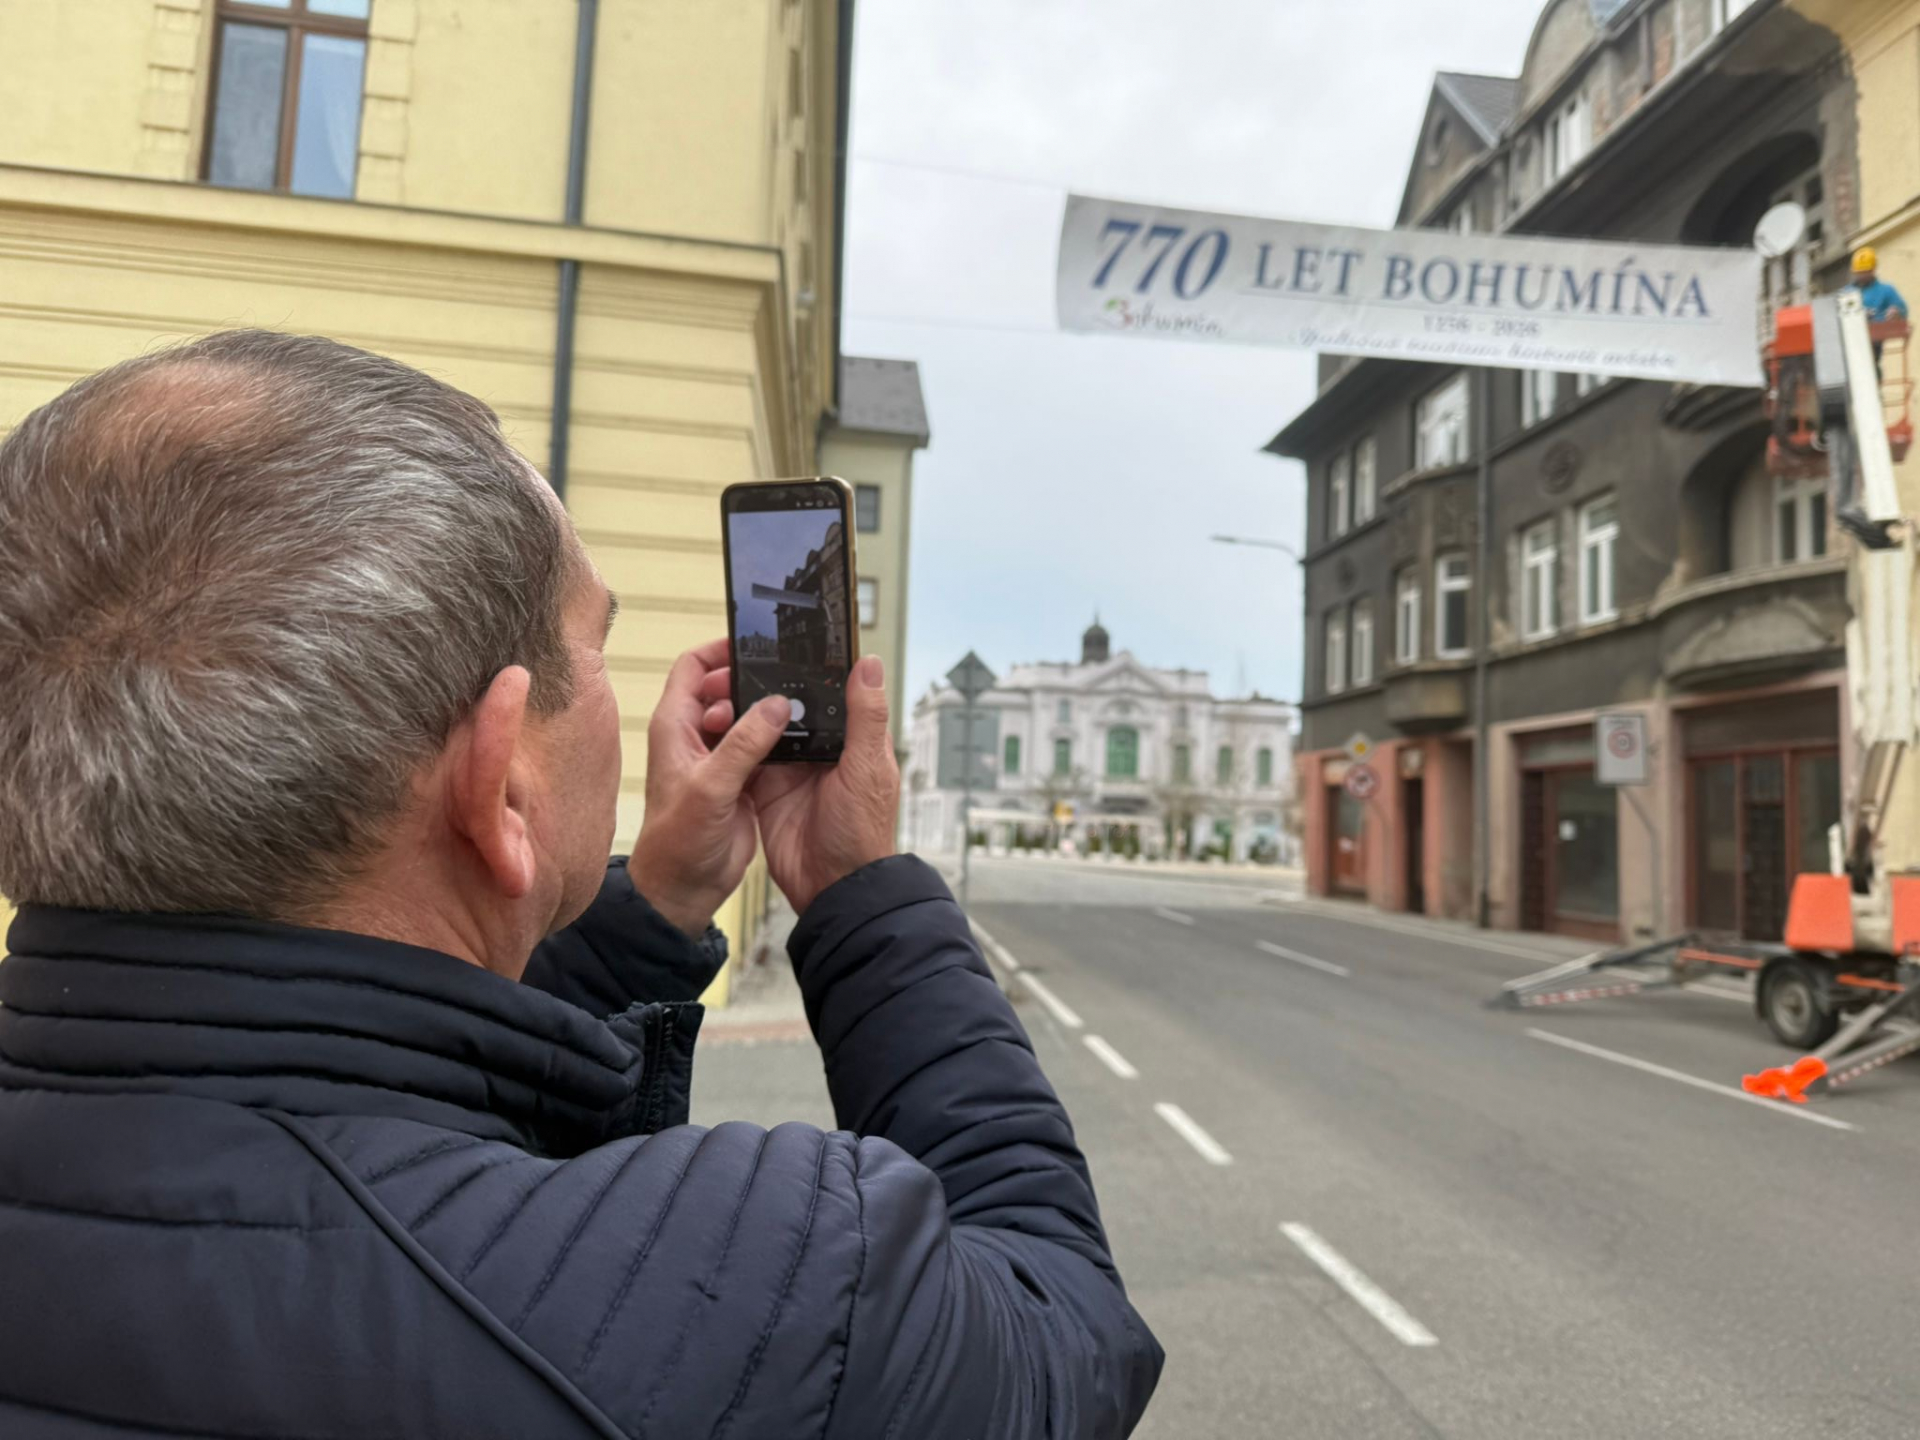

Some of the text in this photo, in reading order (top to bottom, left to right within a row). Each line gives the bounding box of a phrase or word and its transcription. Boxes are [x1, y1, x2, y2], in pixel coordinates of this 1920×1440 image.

[1092, 218, 1711, 317] 770 LET BOHUMÍNA
